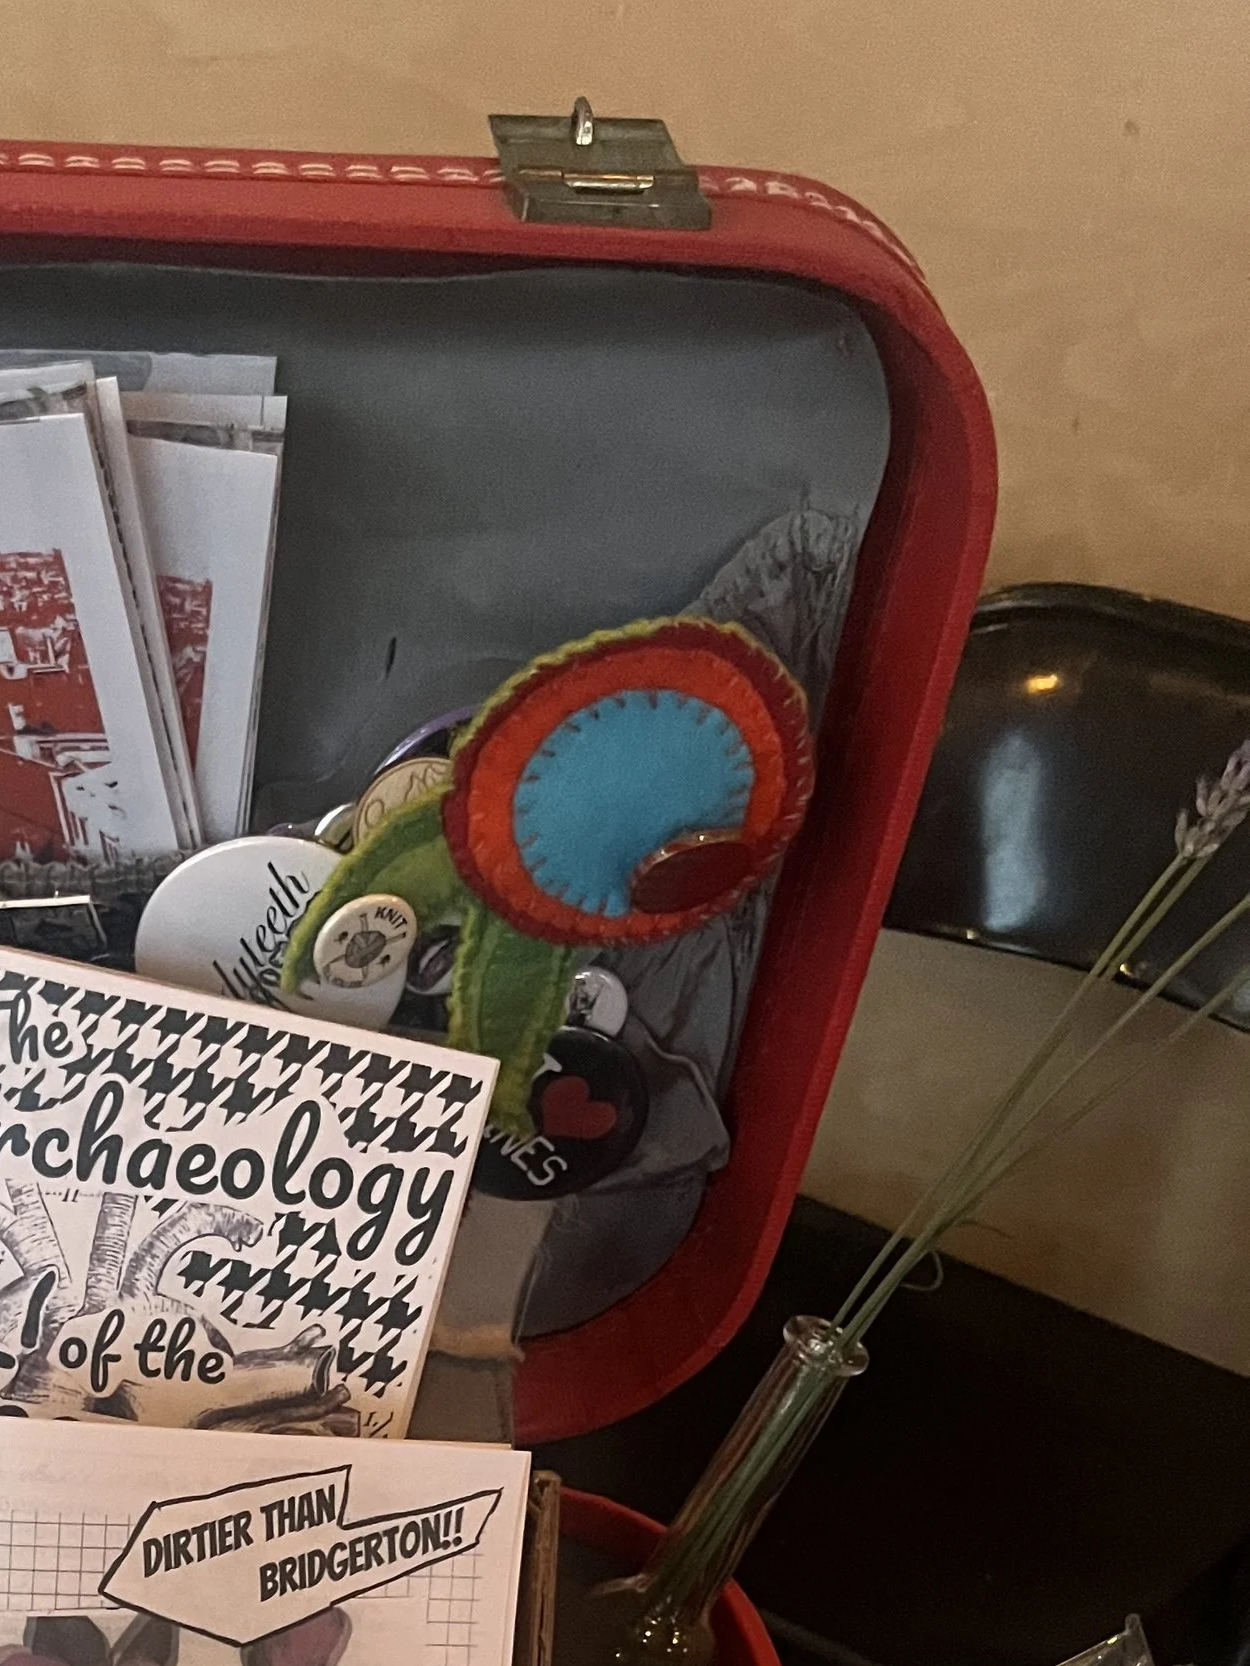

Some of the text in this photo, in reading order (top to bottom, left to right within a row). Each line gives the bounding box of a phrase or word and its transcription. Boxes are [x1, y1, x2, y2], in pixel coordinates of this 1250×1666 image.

[374, 906, 408, 930] KNIT
[483, 1124, 568, 1187] INES
[59, 1309, 122, 1392] of
[134, 1317, 227, 1384] the
[143, 1484, 336, 1578] DIRTIER THAN
[259, 1507, 464, 1602] BRIDGERTON!!
